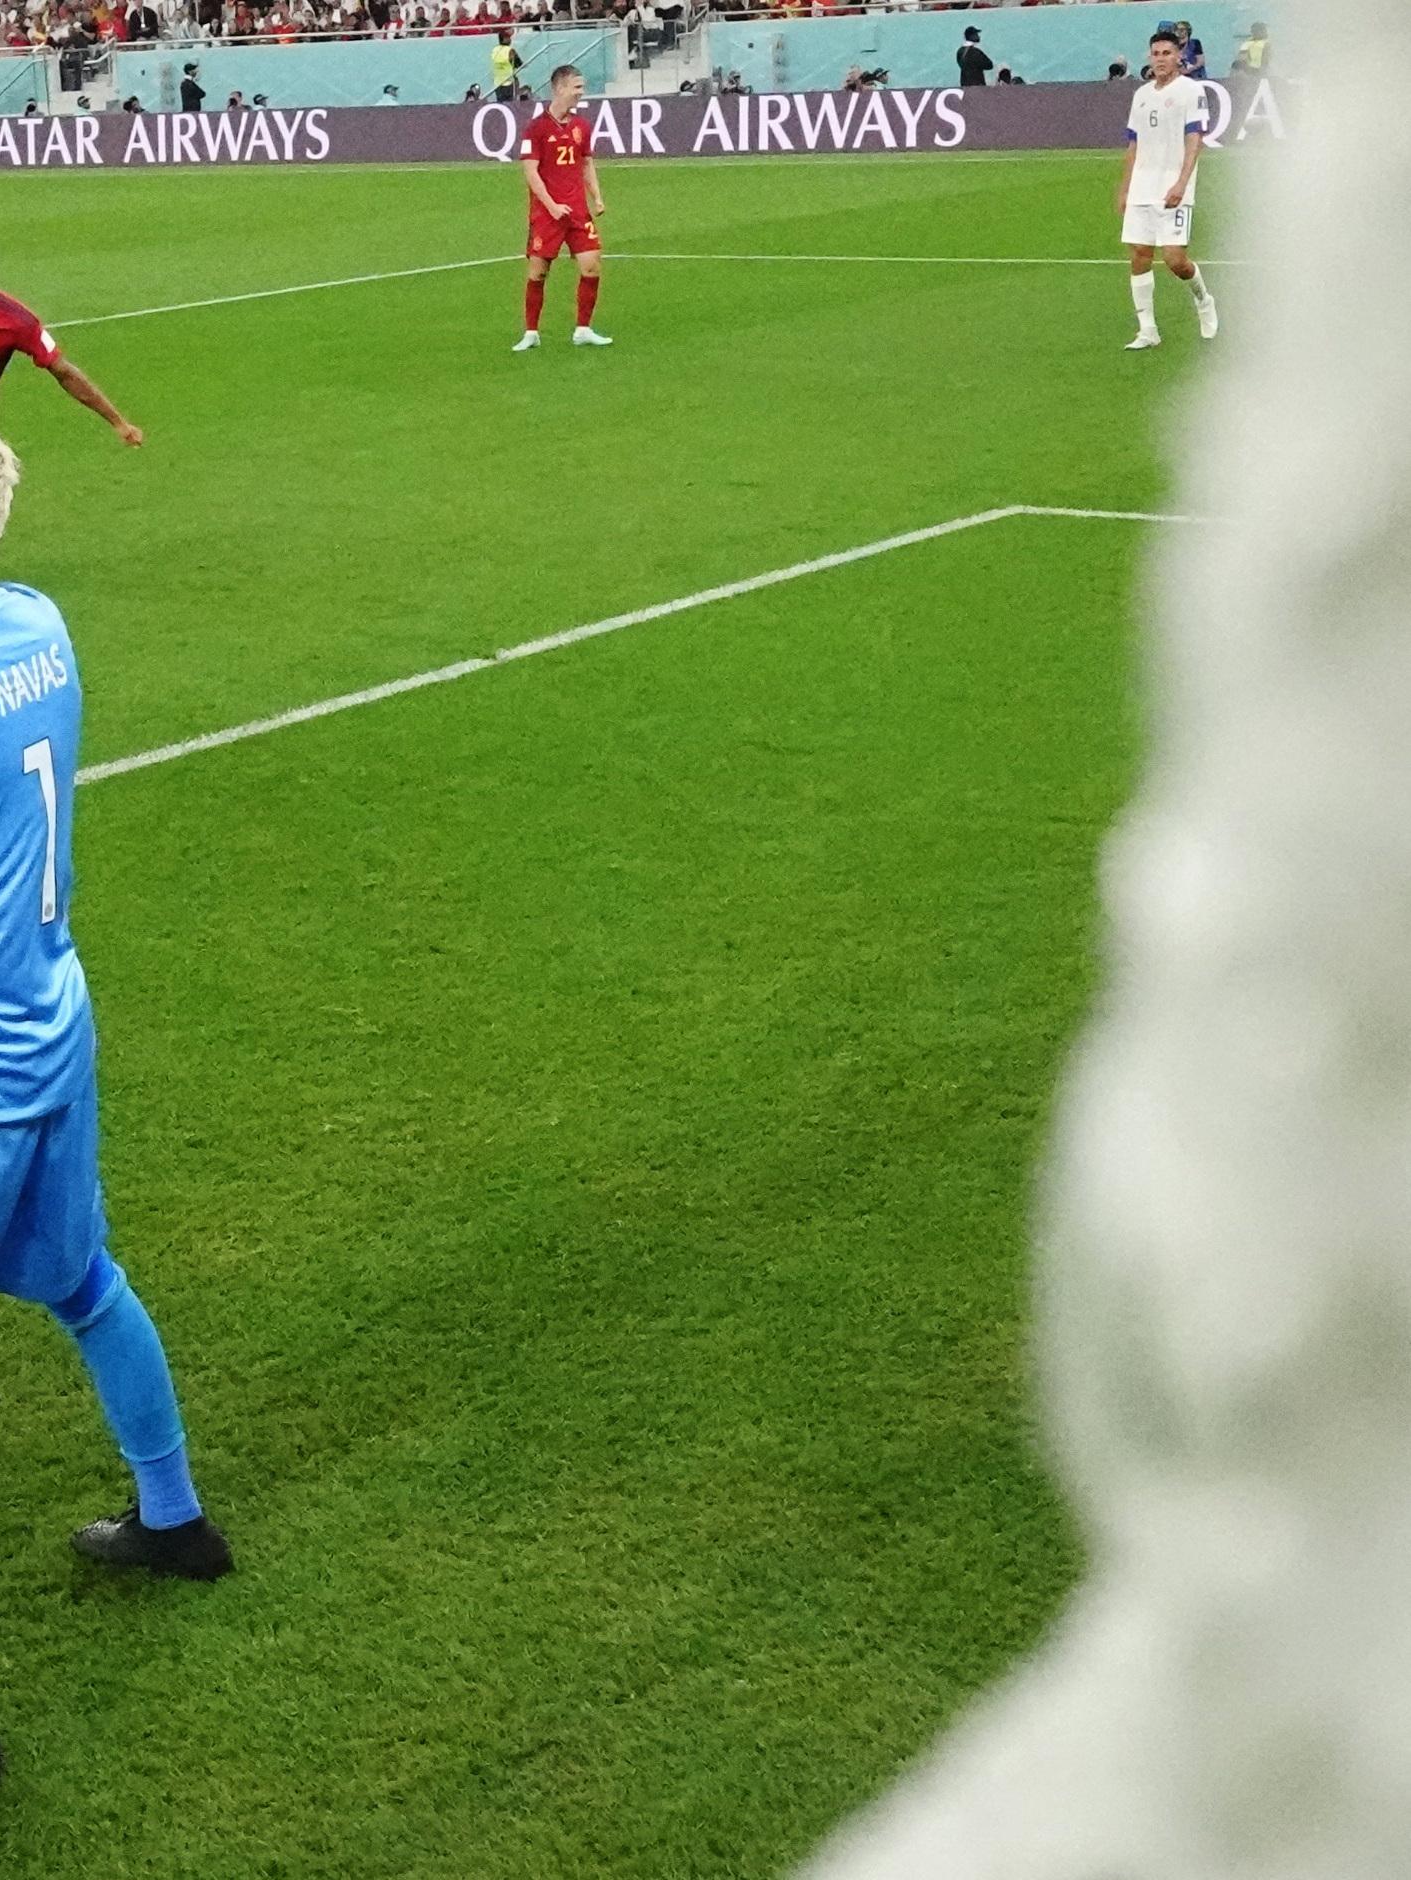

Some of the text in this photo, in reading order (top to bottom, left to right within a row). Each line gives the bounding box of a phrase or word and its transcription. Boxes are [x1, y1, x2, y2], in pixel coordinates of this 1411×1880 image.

[123, 109, 330, 162] AIRWAYS
[472, 89, 966, 163] QAR AIRWAYS
[1149, 110, 1158, 128] 6
[556, 146, 576, 165] 21
[1174, 209, 1185, 228] 6
[23, 736, 58, 925] 1
